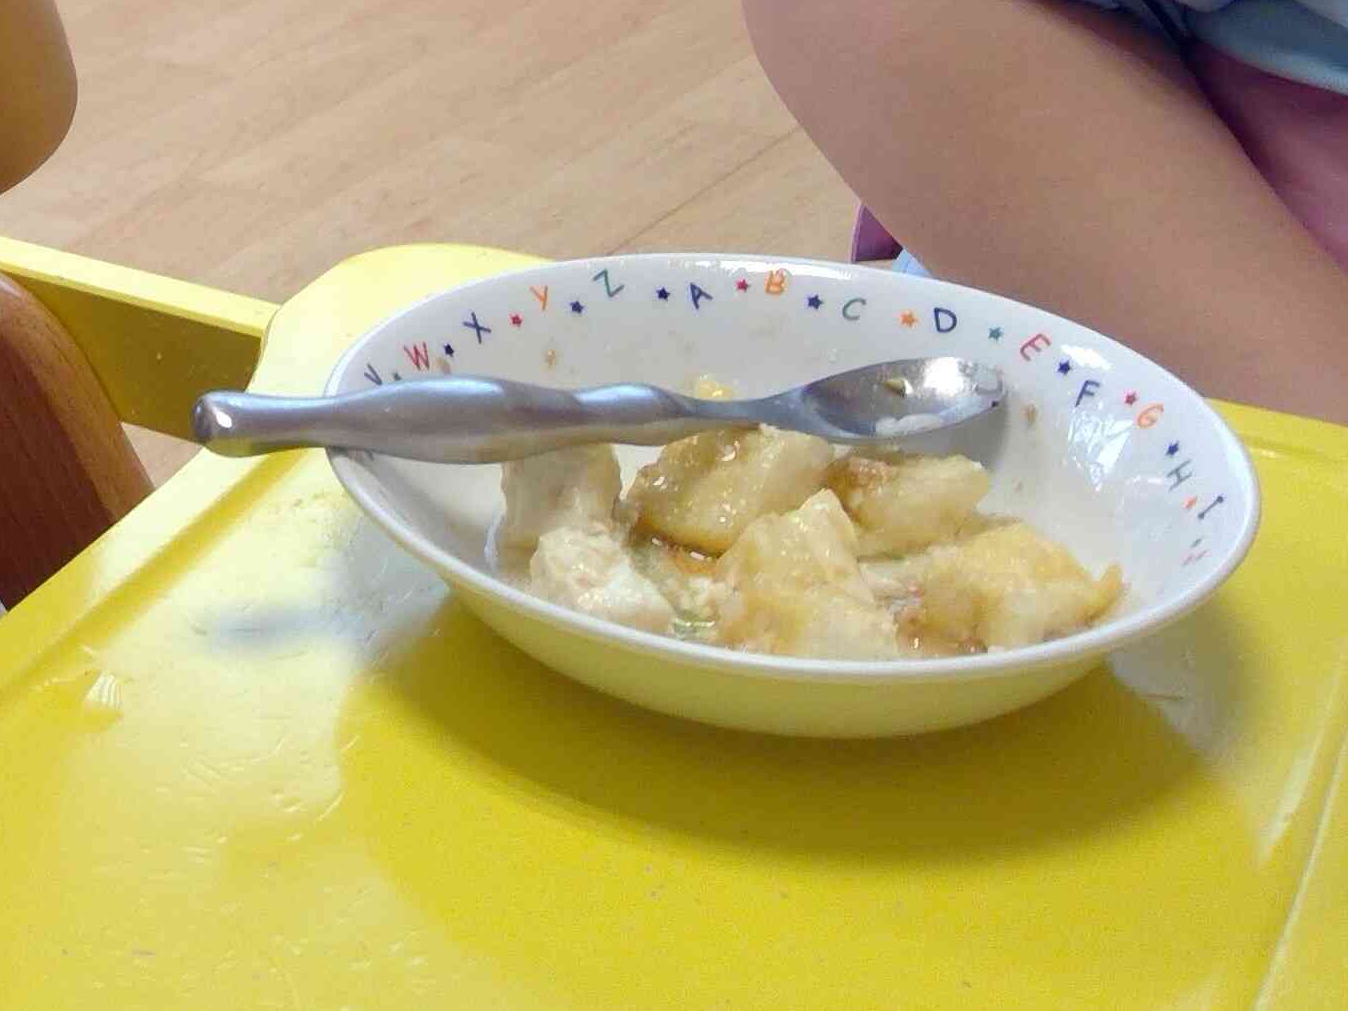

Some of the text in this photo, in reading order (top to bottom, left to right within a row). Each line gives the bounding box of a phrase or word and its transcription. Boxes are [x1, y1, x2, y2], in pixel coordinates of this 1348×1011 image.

[364, 268, 1224, 520] V W X Y Z A B C D E F G H I
